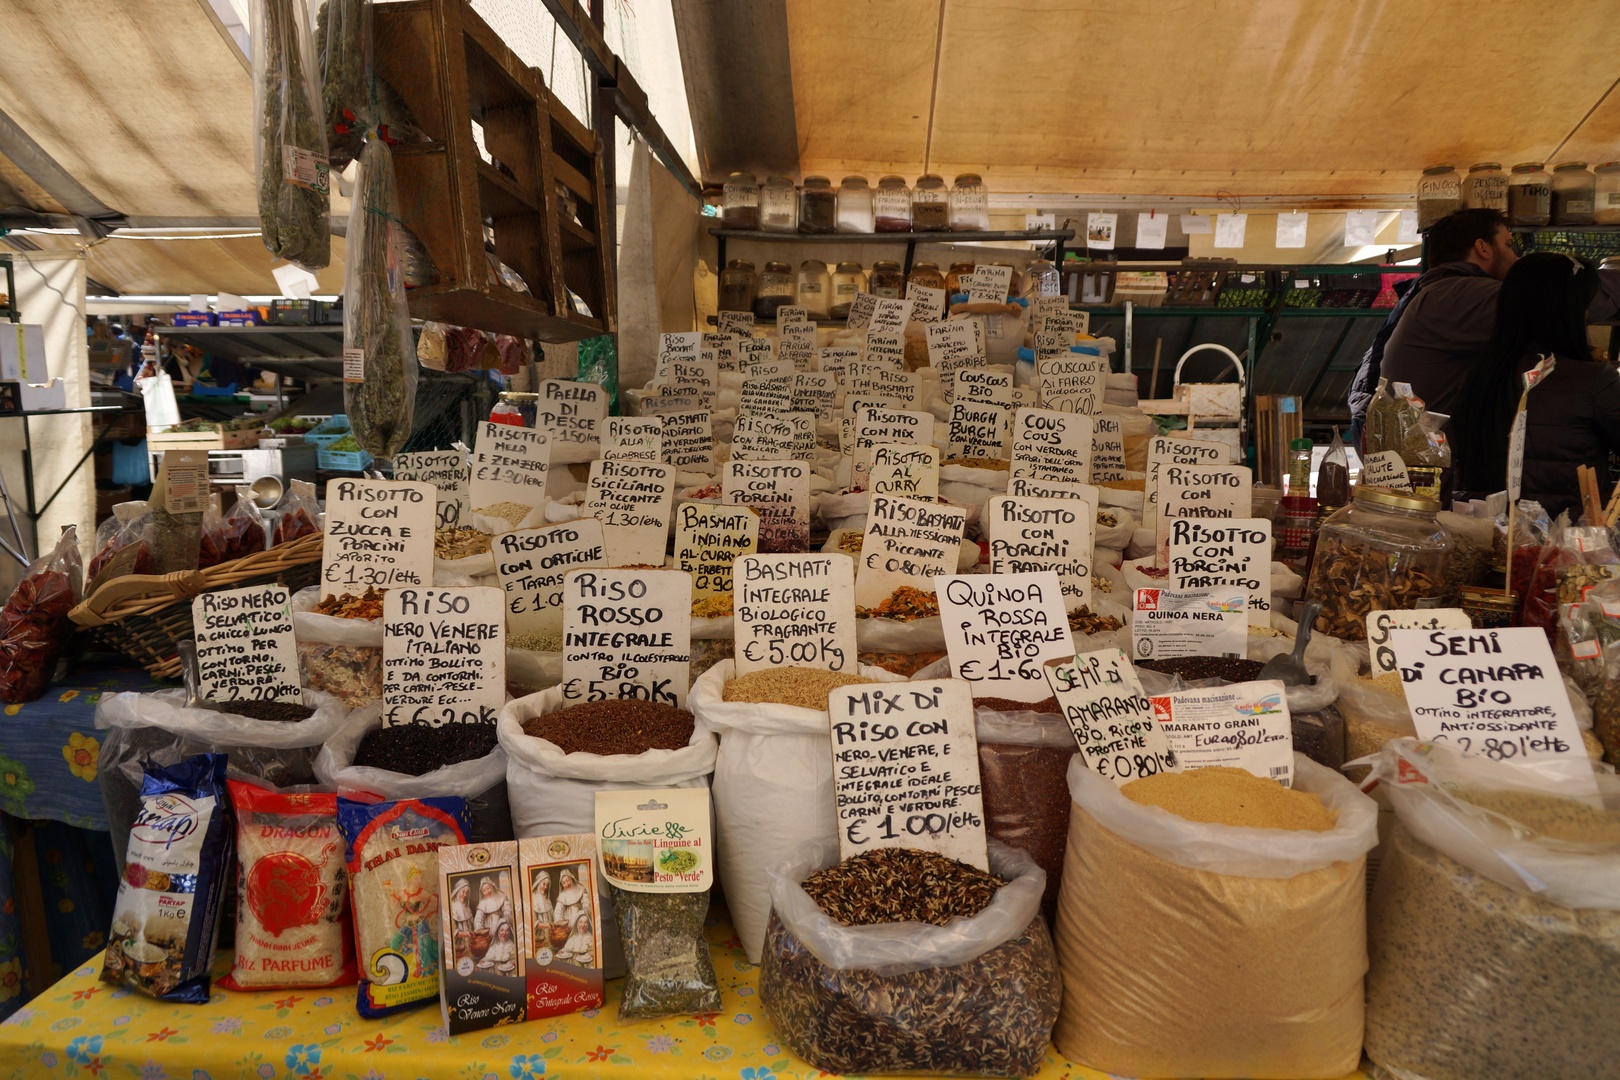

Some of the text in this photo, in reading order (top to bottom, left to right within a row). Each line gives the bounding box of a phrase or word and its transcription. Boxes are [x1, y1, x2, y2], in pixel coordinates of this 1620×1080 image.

[1040, 360, 1096, 375] COUSCOUS
[1059, 375, 1095, 387] FARRO
[546, 382, 596, 402] PAELLA
[541, 412, 596, 430] PESCE
[953, 404, 998, 425] BURGH
[950, 421, 997, 439] BURGH
[1024, 415, 1066, 433] COUS
[861, 427, 890, 438] CON
[1023, 432, 1061, 445] COUS
[620, 438, 644, 446] ALLA
[732, 436, 753, 444] CON
[494, 442, 527, 454] MELA
[1013, 442, 1078, 458] CON VERDURE
[478, 453, 547, 472] E ZENZERO
[604, 450, 656, 461] CALABRESE
[1173, 456, 1197, 464] CON
[891, 467, 912, 478] AL
[748, 480, 776, 490] CON
[876, 478, 921, 493] CURRY
[1181, 490, 1211, 500] CON
[361, 506, 398, 519] CON
[329, 521, 411, 538] ZUCCA E
[1021, 528, 1055, 540] CON
[1192, 545, 1234, 558] CON
[500, 560, 532, 576] CON
[866, 553, 879, 569] €
[992, 560, 1003, 574] E
[506, 581, 514, 592] E
[241, 591, 286, 608] NERO
[510, 597, 526, 613] €
[578, 605, 663, 626] ROSSO
[981, 609, 1048, 627] ROSSA
[1148, 611, 1224, 621] QUINOA NERA
[196, 623, 292, 643] A LUNGO
[385, 620, 499, 639] NERO VENERE
[752, 622, 837, 638] FRAGRANTE
[252, 639, 278, 650] PER
[567, 652, 614, 662] CONTRO
[387, 671, 420, 682] E DA
[959, 660, 985, 682] €
[1439, 663, 1545, 685] CANAPA
[383, 684, 400, 694] PER
[563, 678, 583, 699] €
[385, 694, 433, 704] VERDURE
[1067, 695, 1150, 726] AMARANTO
[905, 717, 948, 737] CON
[1224, 718, 1260, 729] GRANI
[943, 743, 951, 756] E
[919, 761, 932, 774] E
[944, 782, 981, 796] PESCE
[887, 803, 894, 815] E
[260, 825, 331, 839] DRAGON
[846, 818, 868, 845] €
[654, 839, 691, 850] Linguine
[694, 837, 701, 846] al
[364, 847, 401, 871] THAI
[654, 872, 673, 882] Pesto
[250, 935, 272, 949] THANH
[293, 935, 318, 950] JEUNE
[535, 982, 558, 995] Riso
[457, 994, 480, 1008] Riso
[574, 992, 598, 1003] Rosso
[492, 1001, 517, 1016] Nero
